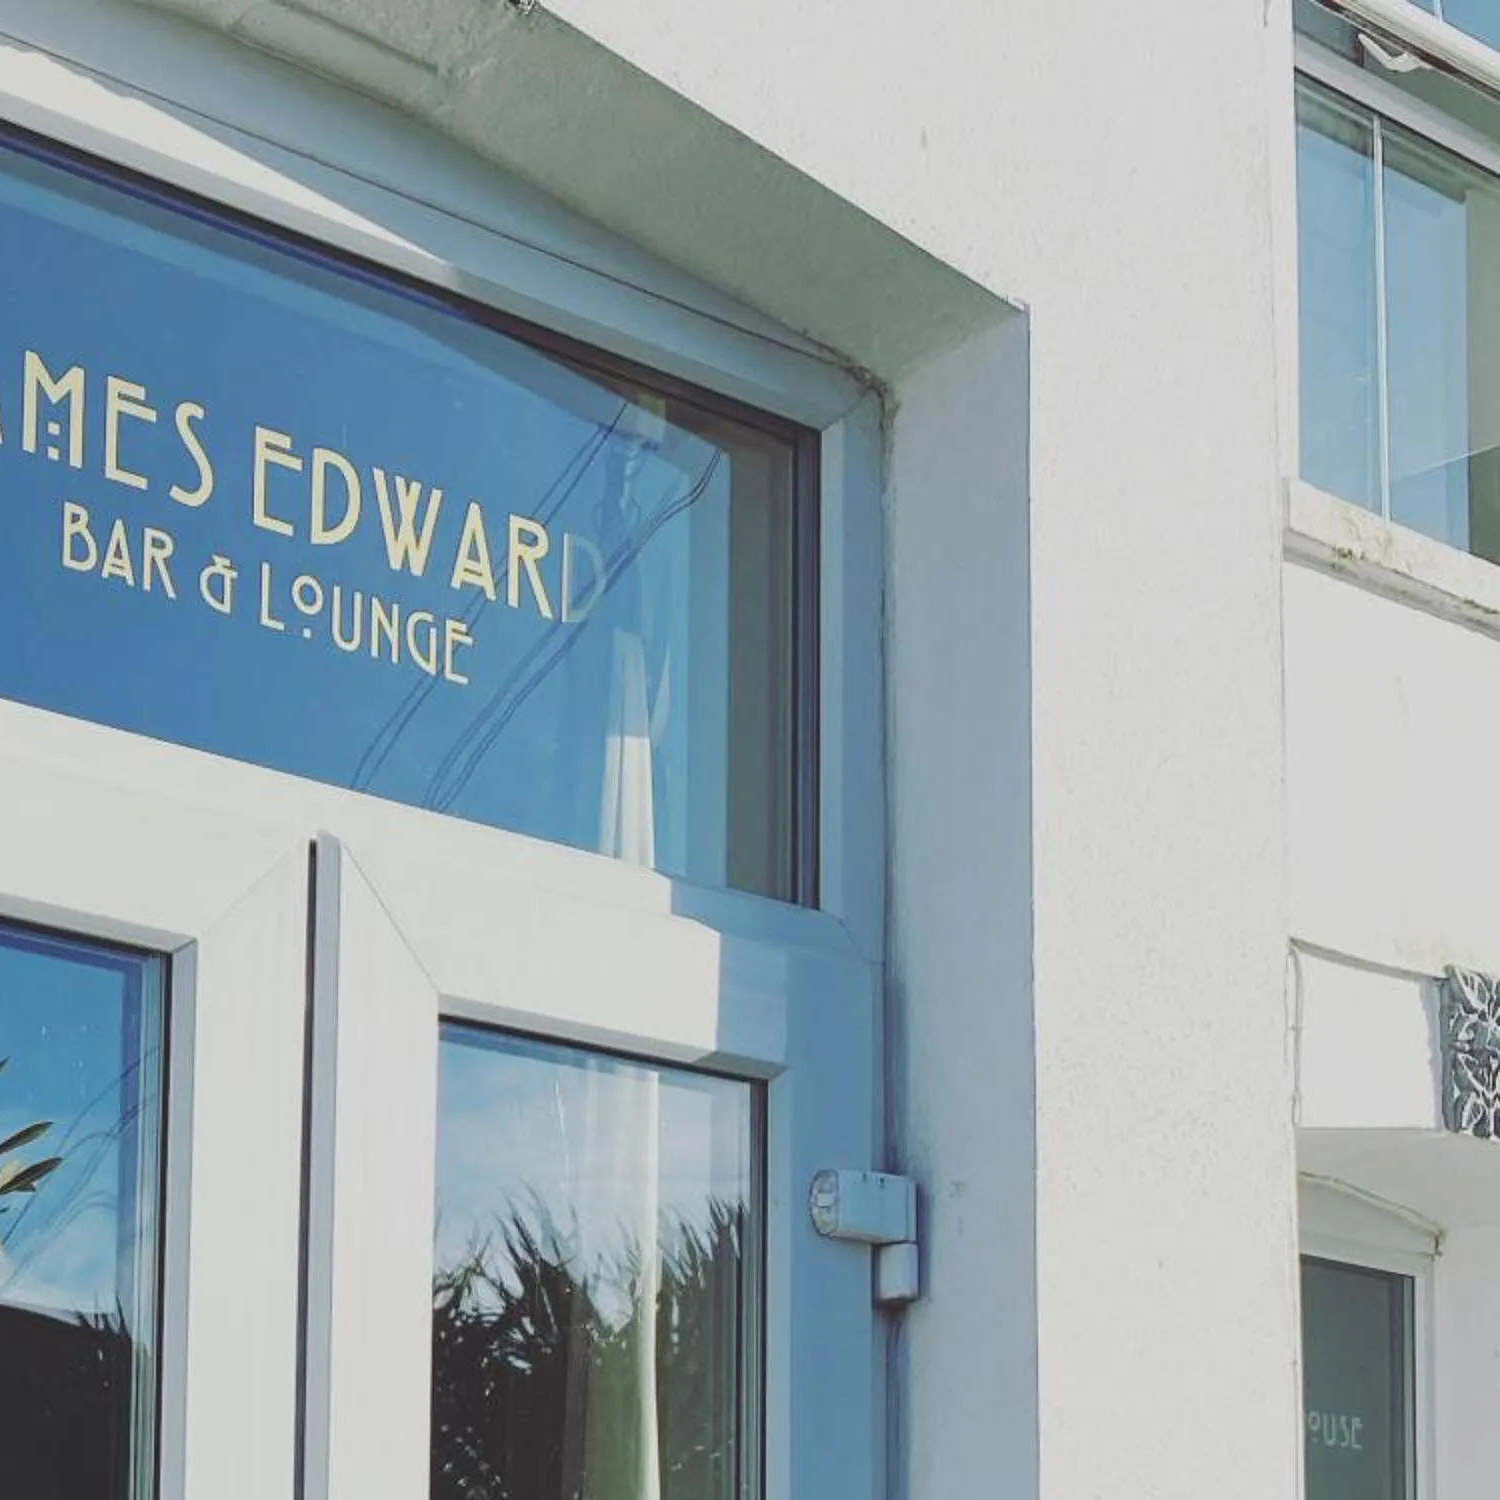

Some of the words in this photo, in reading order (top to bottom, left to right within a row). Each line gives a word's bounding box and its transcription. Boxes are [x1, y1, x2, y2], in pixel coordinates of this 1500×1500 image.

[62, 501, 177, 599] BAR
[199, 554, 238, 614] &
[260, 562, 474, 685] LOUNGE
[252, 425, 607, 623] EDWARD
